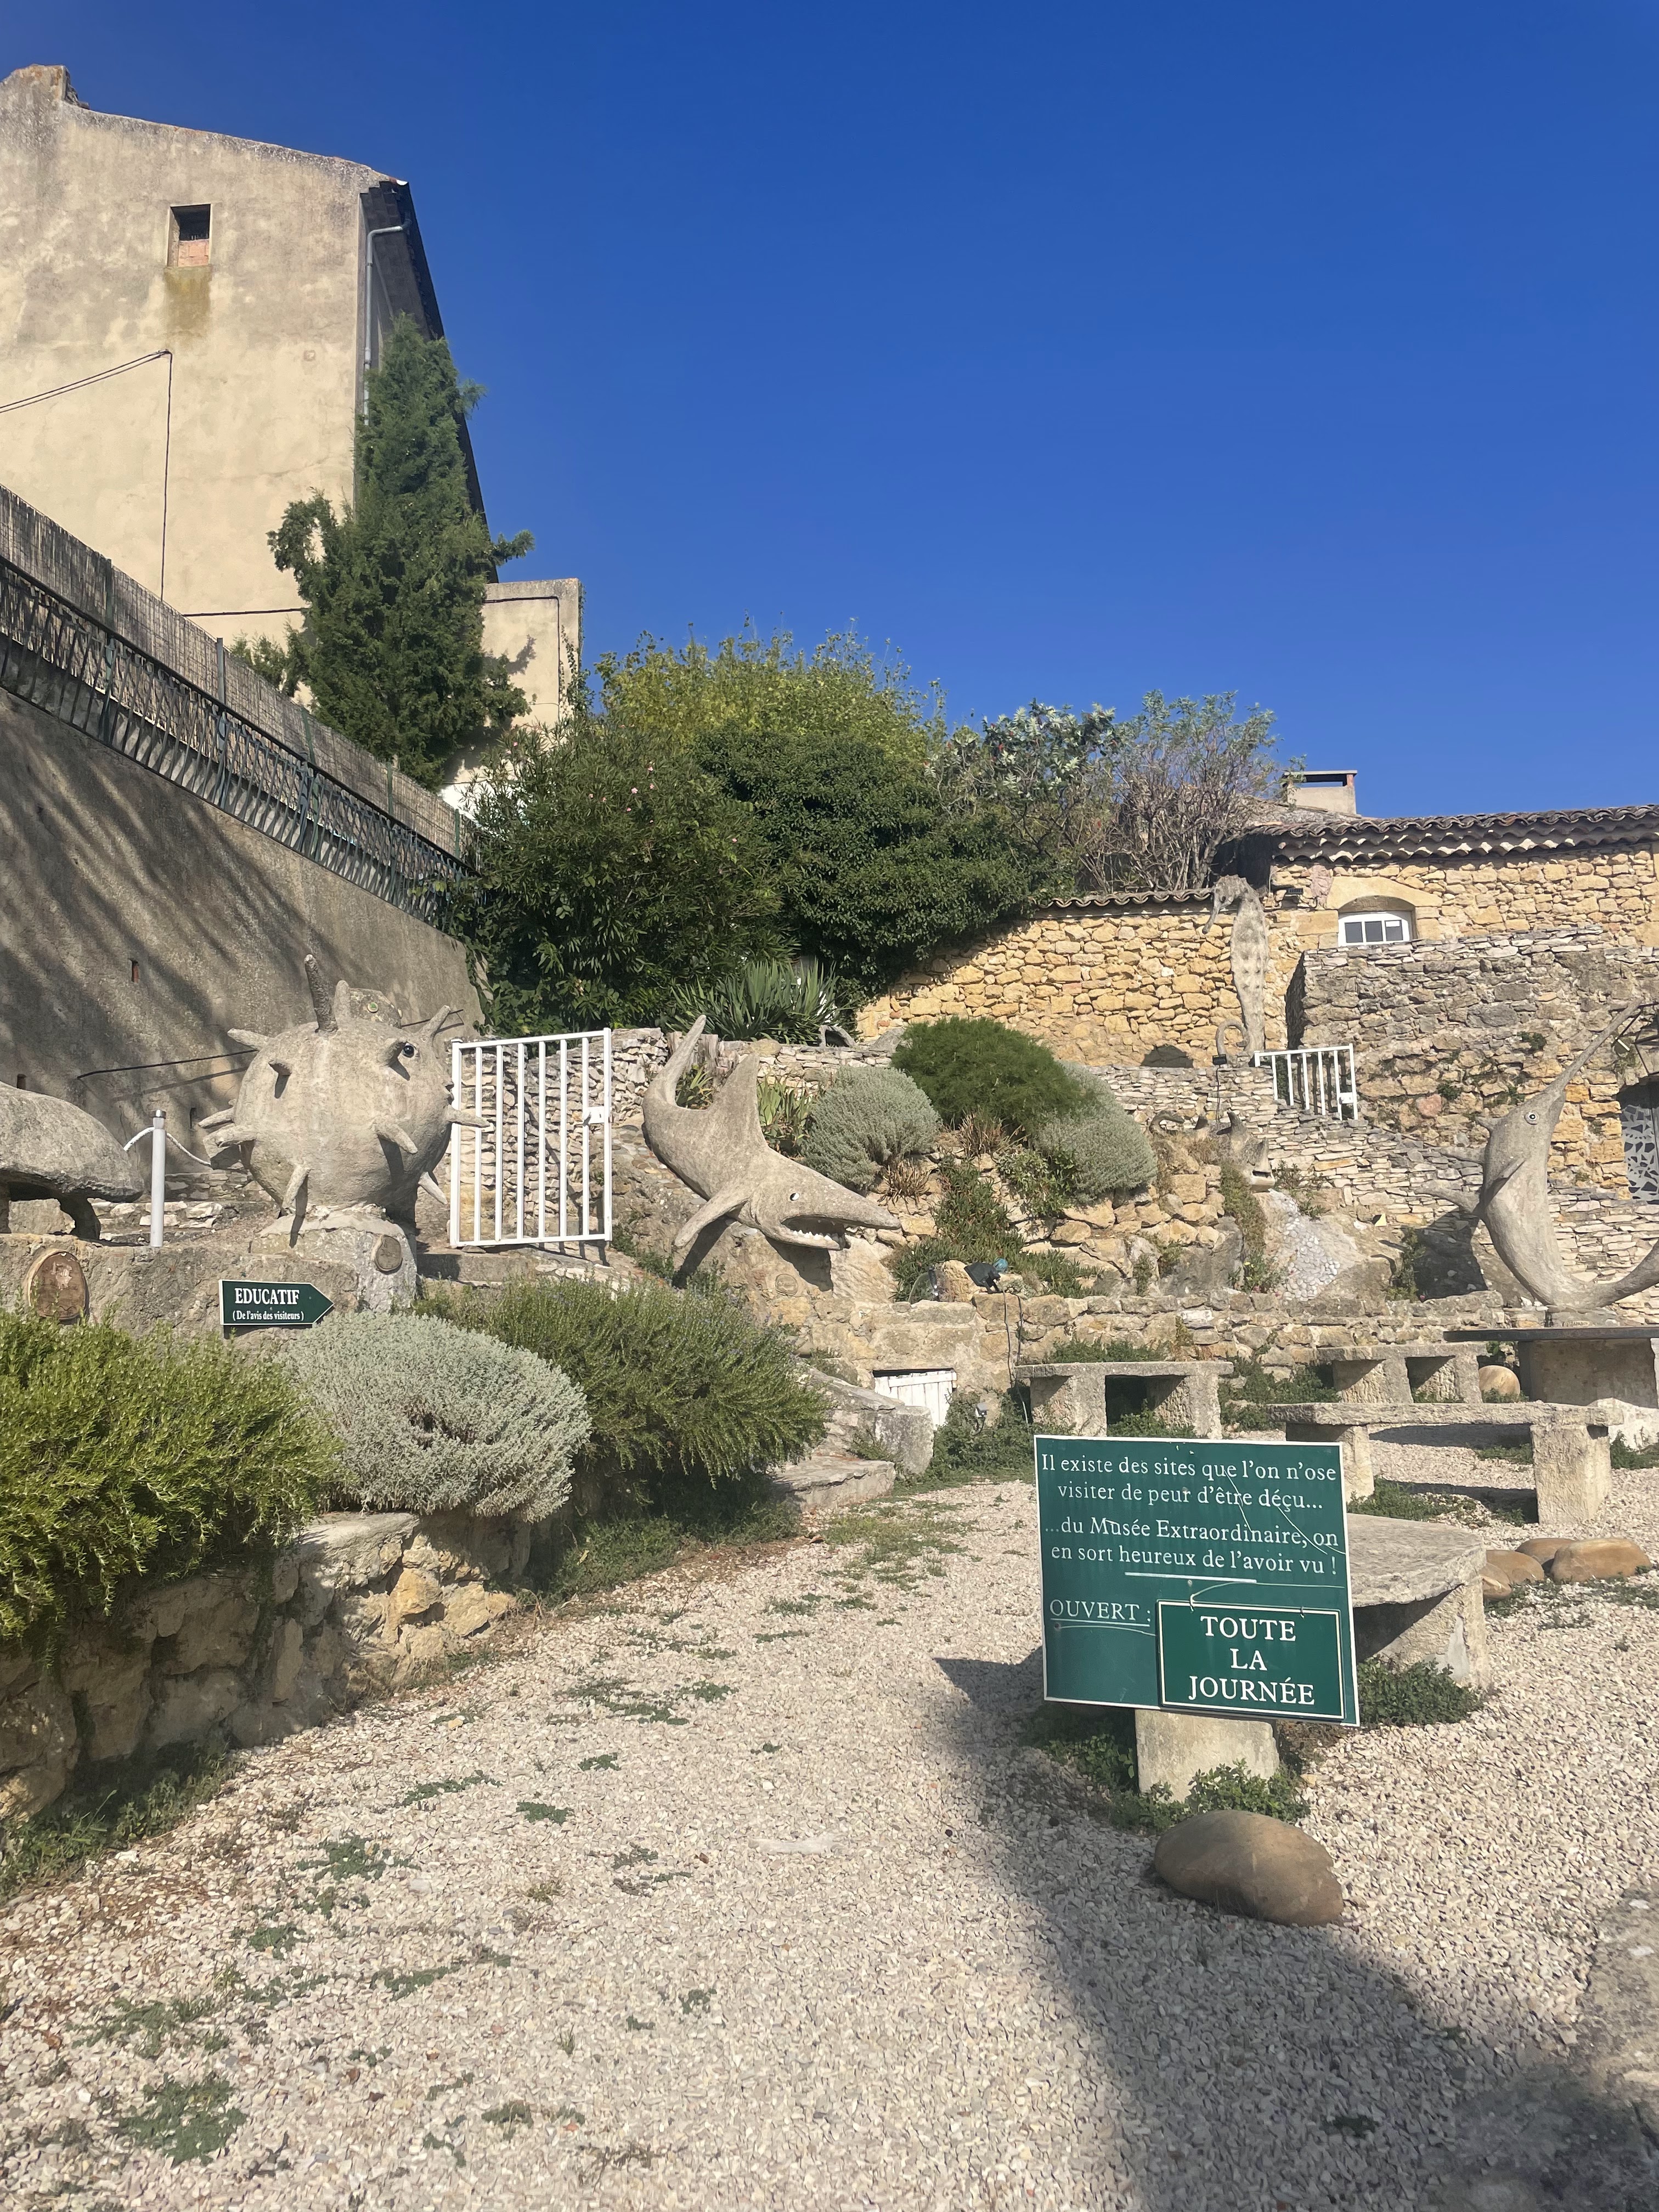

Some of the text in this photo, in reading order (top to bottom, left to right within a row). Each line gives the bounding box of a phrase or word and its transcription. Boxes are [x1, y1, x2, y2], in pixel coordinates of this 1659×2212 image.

[234, 1288, 300, 1305] EDUCATIF
[246, 1310, 262, 1320] l'avis
[263, 1311, 273, 1320] des
[1042, 1454, 1336, 1481] Il existe des sites que l'on n'ose
[1057, 1481, 1323, 1513] visiter de peur d'être déçu...
[1090, 1516, 1150, 1537] Musée
[1155, 1519, 1308, 1549] Extraordinaire,
[1313, 1532, 1339, 1547] on
[1051, 1546, 1072, 1560] en
[1077, 1548, 1113, 1562] sort
[1119, 1545, 1197, 1566] heureux
[1202, 1549, 1225, 1568] de
[1230, 1550, 1294, 1572] l'avoir
[1299, 1559, 1325, 1573] vu
[1049, 1599, 1141, 1621] OUVERT
[1200, 1615, 1297, 1642] TOUTE
[1229, 1648, 1268, 1672] LA
[1188, 1675, 1316, 1706] JOURNÉE
